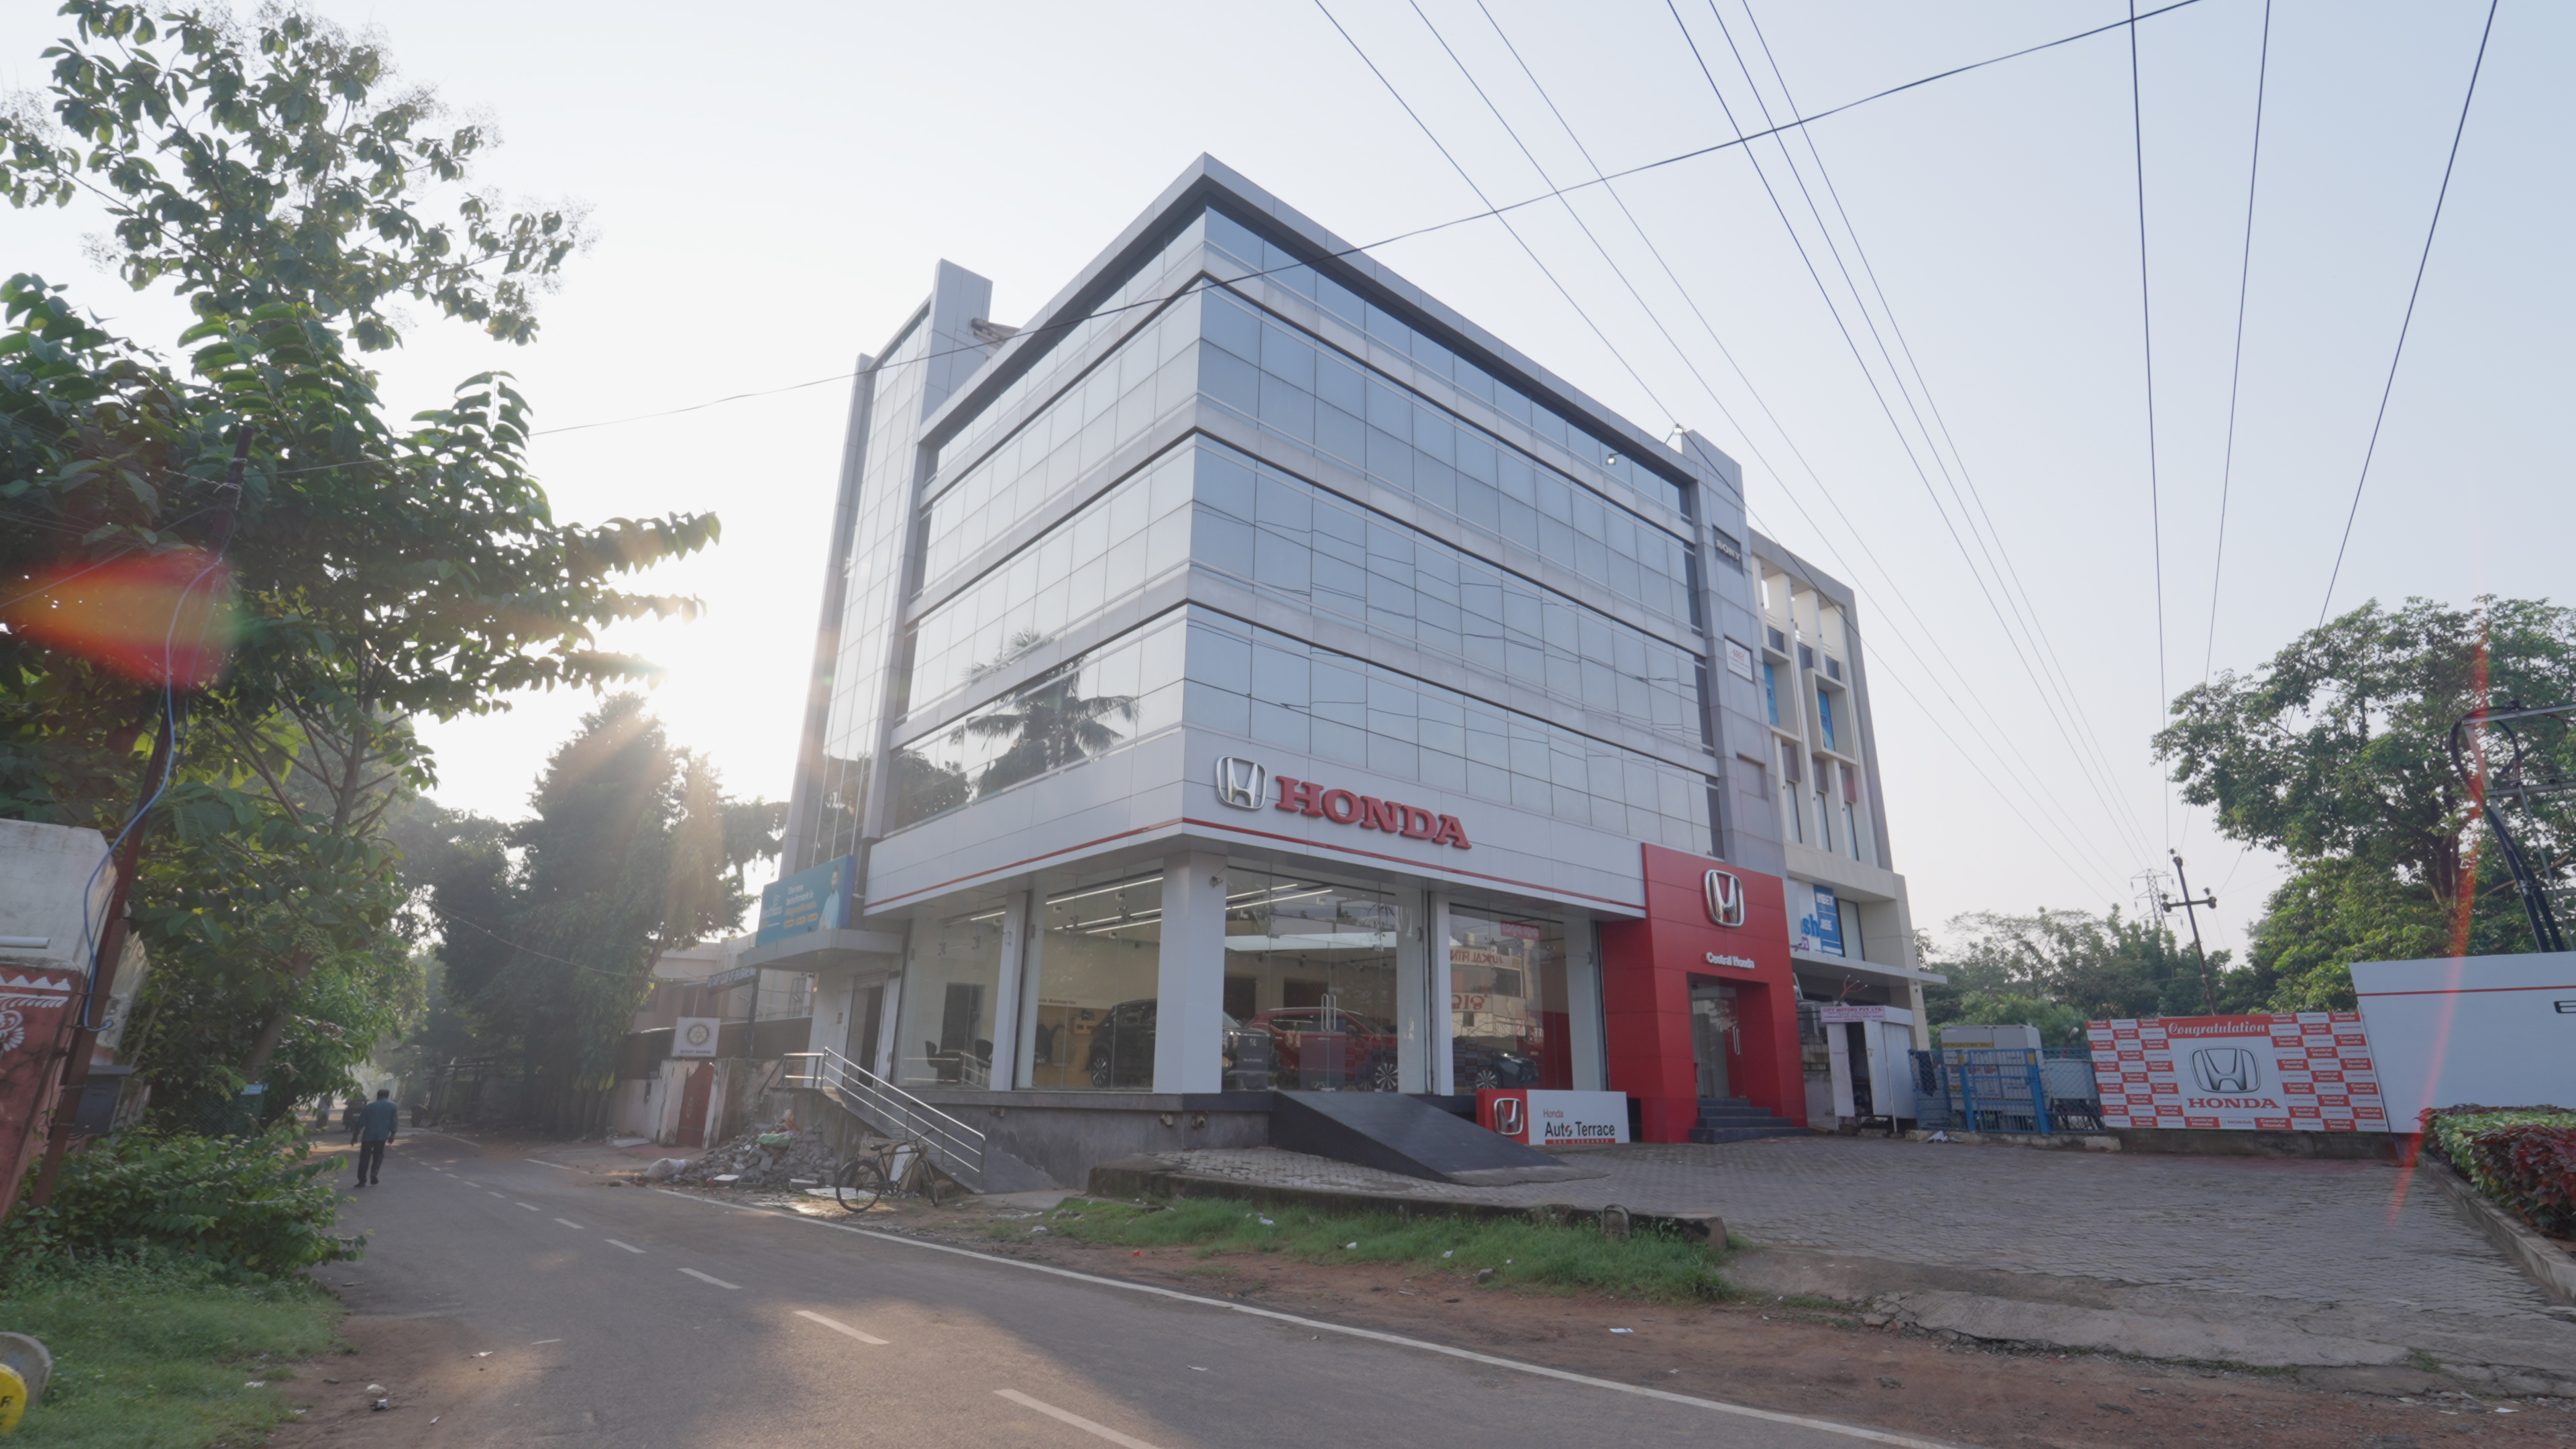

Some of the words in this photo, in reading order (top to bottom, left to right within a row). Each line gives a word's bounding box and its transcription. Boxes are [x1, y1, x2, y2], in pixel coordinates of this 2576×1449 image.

[1716, 539, 1740, 560] SONY
[1275, 775, 1472, 850] HONDA
[1815, 892, 1833, 906] NEET
[1706, 952, 1732, 966] Central
[1732, 955, 1755, 969] Honda
[2168, 1020, 2265, 1037] Congratulation
[2186, 1097, 2281, 1109] HONDA
[1543, 1109, 1564, 1118] Honda
[1545, 1122, 1573, 1137] Auto
[1575, 1121, 1615, 1136] Terrace
